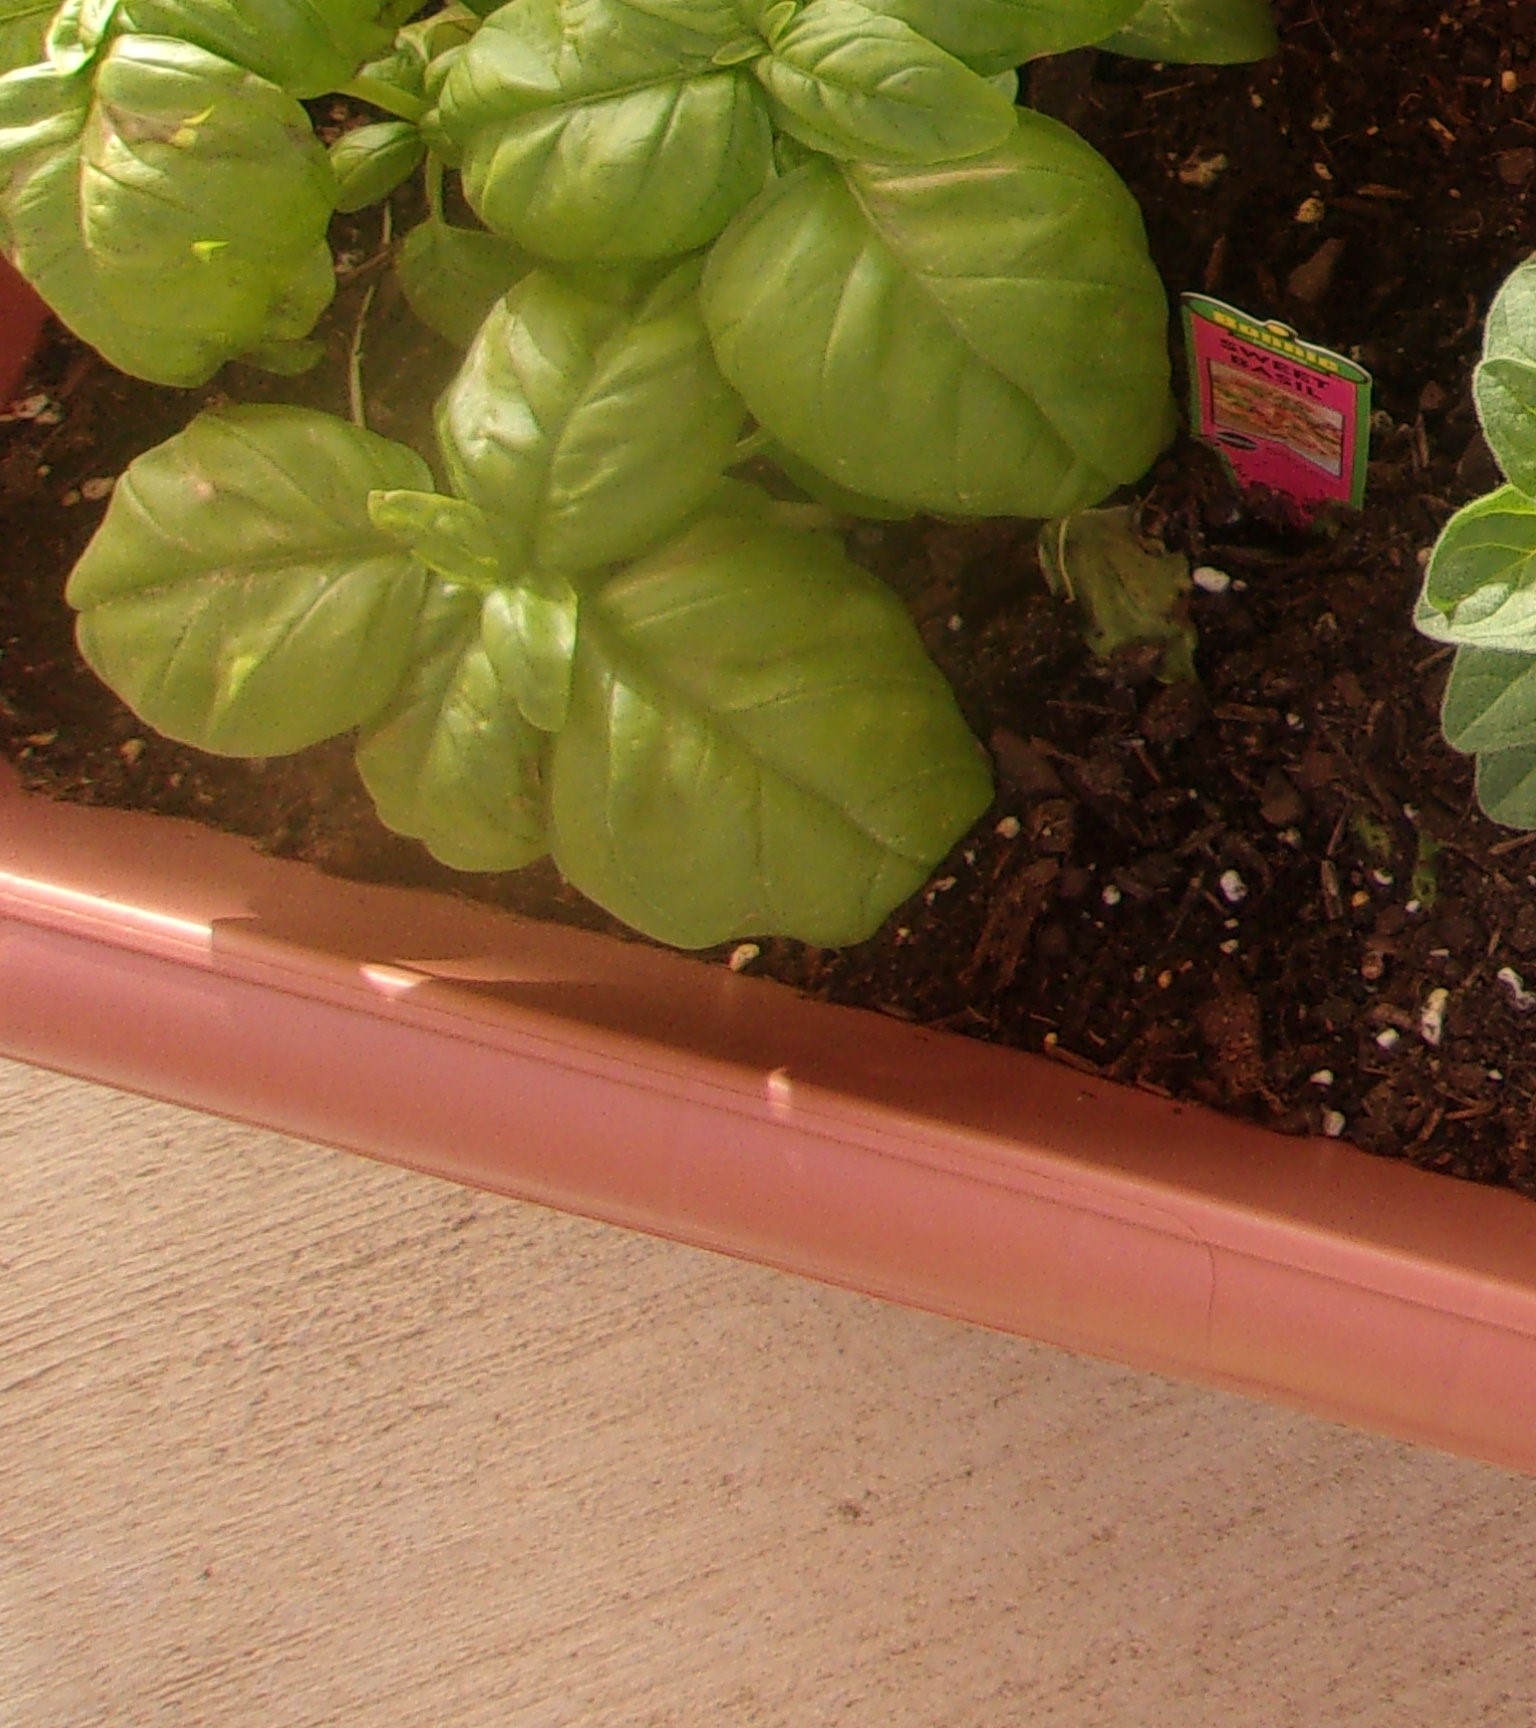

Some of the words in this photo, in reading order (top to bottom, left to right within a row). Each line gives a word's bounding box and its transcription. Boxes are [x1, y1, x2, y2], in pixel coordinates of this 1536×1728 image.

[1212, 311, 1339, 372] Bonnie
[1219, 337, 1331, 390] SWEET
[1230, 353, 1322, 401] BASIL
